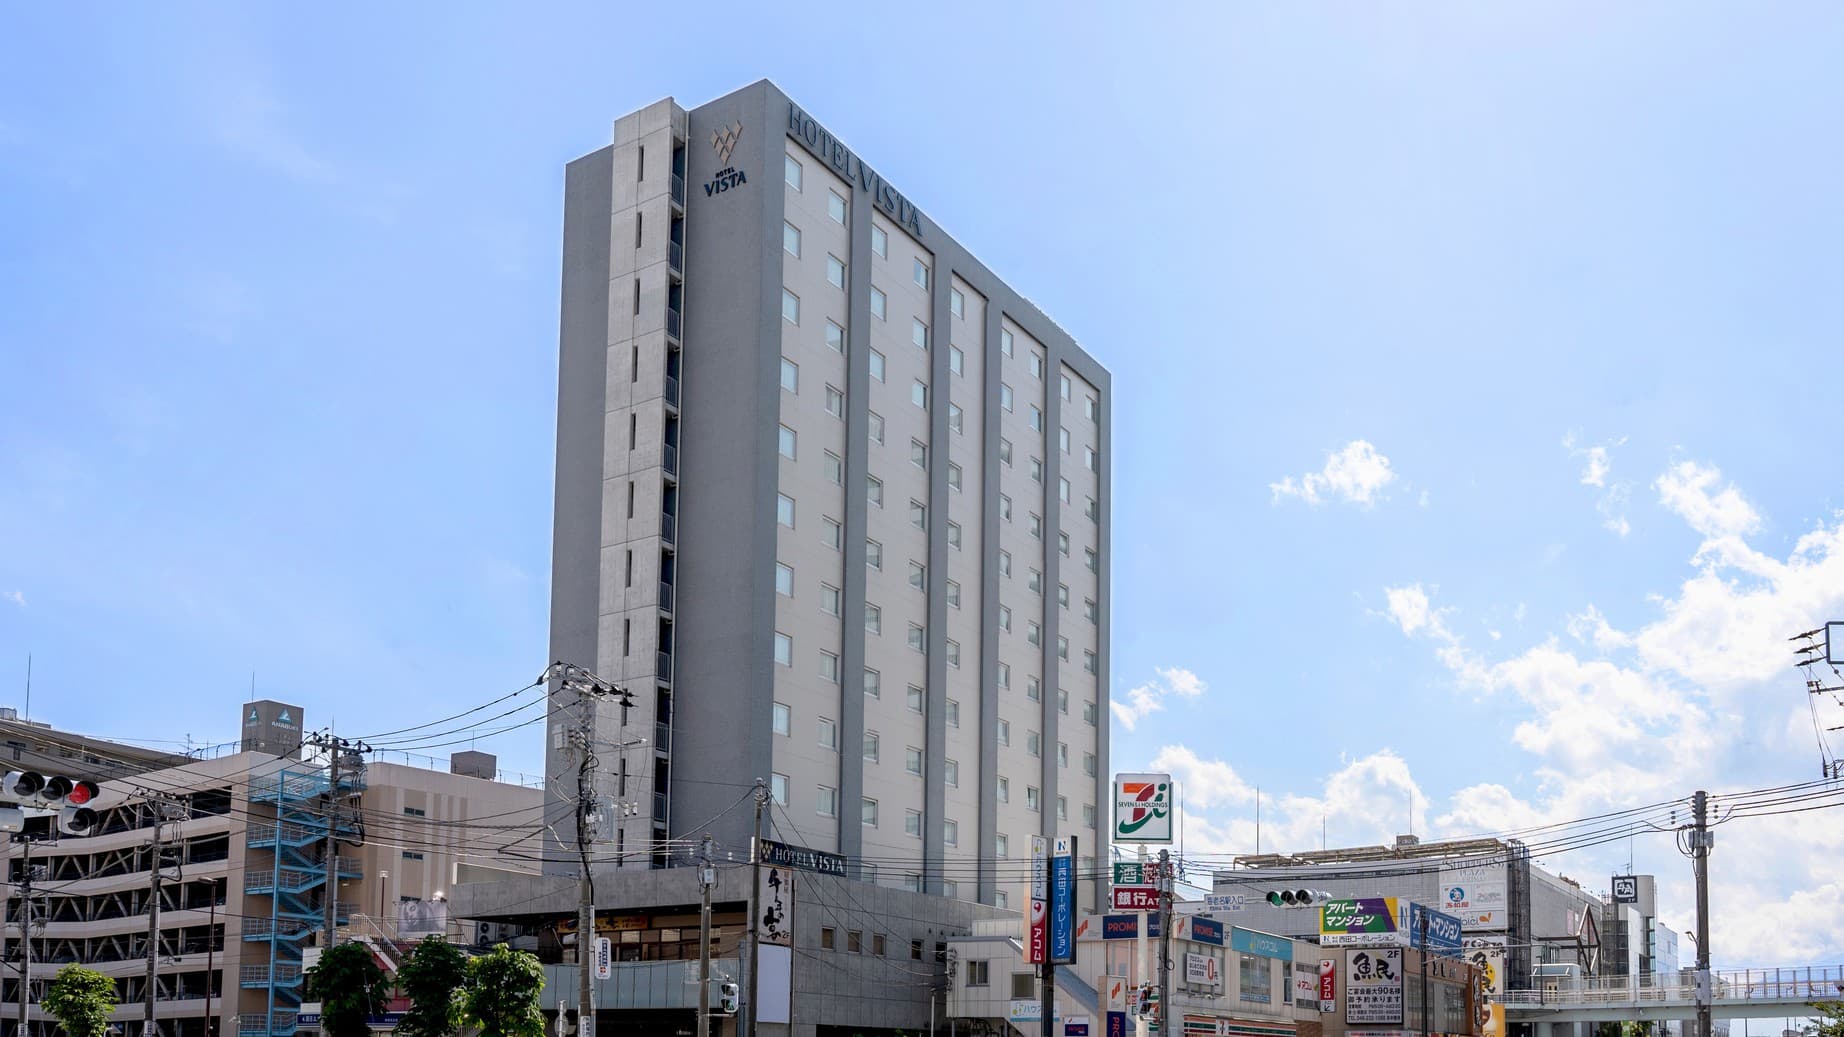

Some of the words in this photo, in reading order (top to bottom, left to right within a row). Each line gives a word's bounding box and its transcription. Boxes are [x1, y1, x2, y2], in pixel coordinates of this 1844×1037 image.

[715, 166, 736, 179] HOTEL
[788, 102, 857, 182] HOTEL
[857, 158, 923, 237] VISTA
[704, 170, 747, 197] VISTA
[775, 847, 809, 868] HOTEL
[809, 852, 844, 874] VISTA
[1119, 865, 1138, 883] 酒
[1117, 891, 1160, 906] 銀行AT
[1107, 922, 1138, 932] PROMI
[1326, 915, 1374, 927] マンション
[1033, 927, 1042, 961] アコム
[1387, 950, 1400, 959] 2F
[1353, 952, 1395, 981] 魚民
[1323, 977, 1331, 999] アコム
